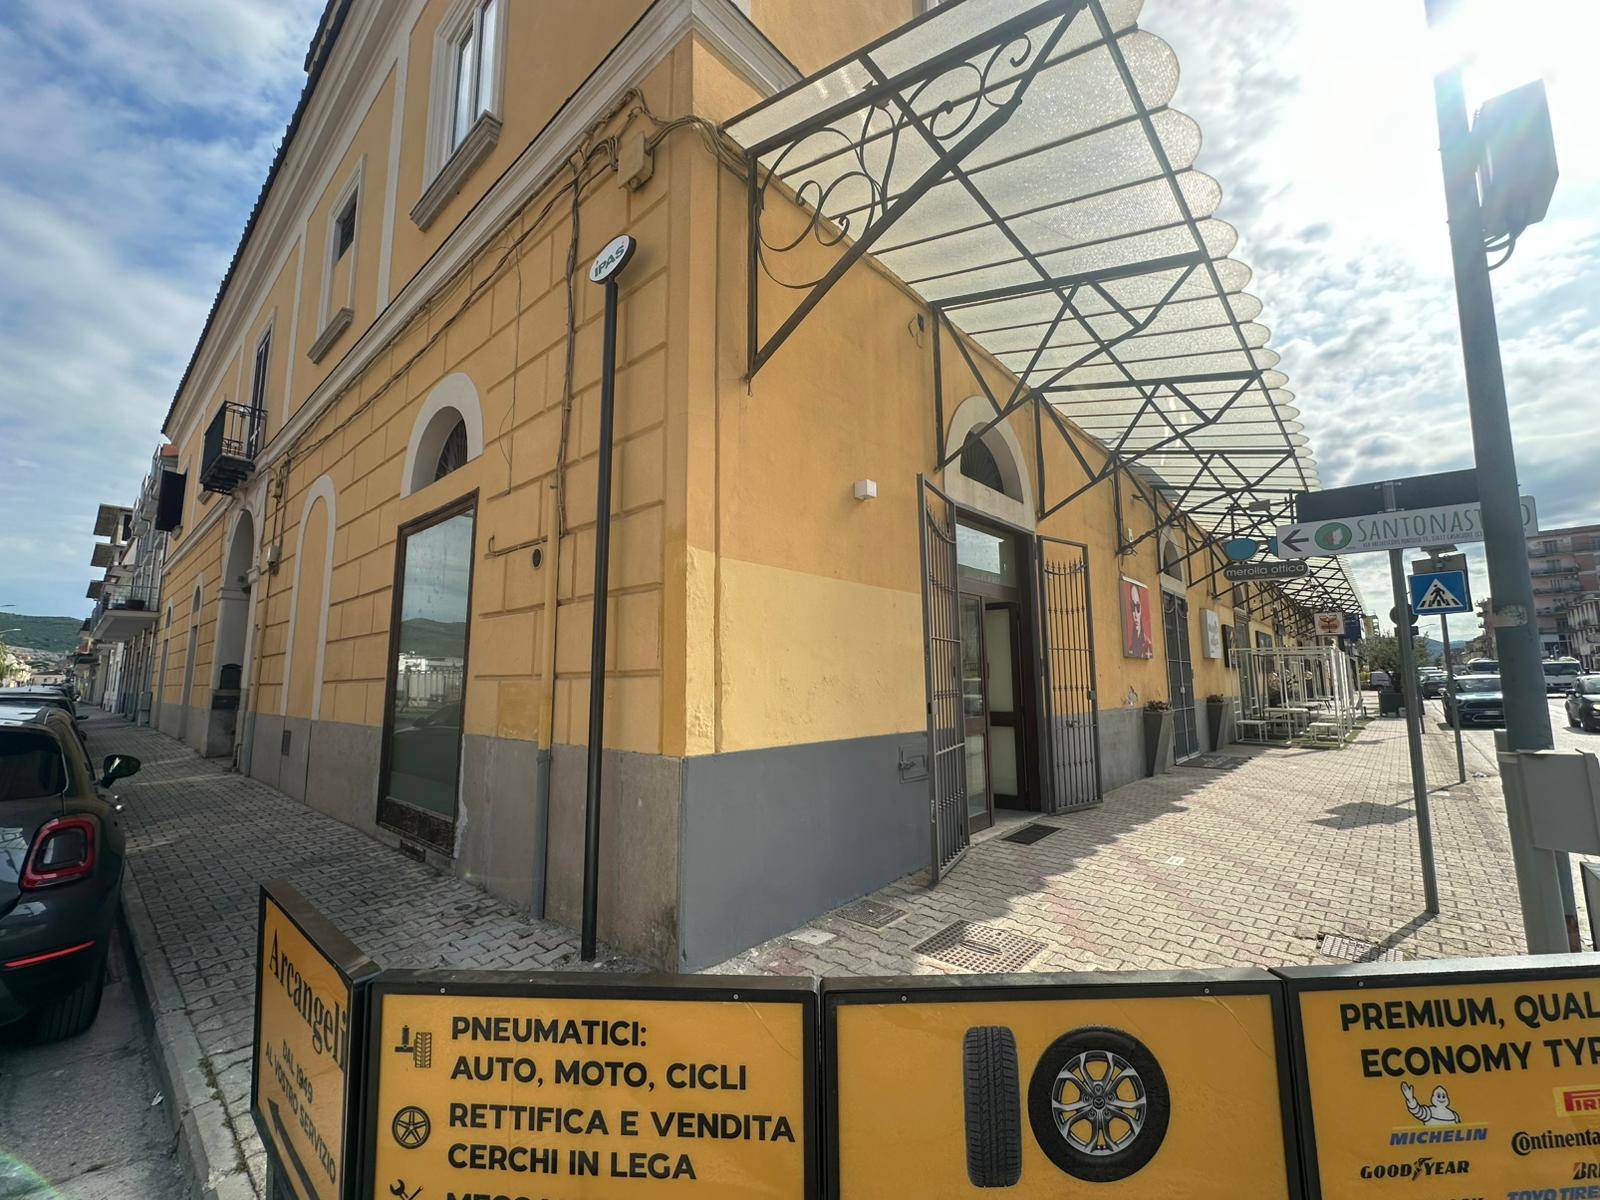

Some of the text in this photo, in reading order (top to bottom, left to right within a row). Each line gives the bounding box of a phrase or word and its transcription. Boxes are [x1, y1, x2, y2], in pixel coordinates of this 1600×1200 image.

[594, 244, 625, 278] IPAS
[1226, 566, 1268, 577] merolla
[1271, 563, 1305, 574] ottica
[269, 928, 348, 1071] Arcangeli
[1340, 997, 1505, 1031] PREMIUM,
[451, 1016, 647, 1047] PNEUMATICI:
[282, 1039, 313, 1104] DAL 1949
[450, 1055, 747, 1092] AUTO, MOTO, CICLI
[1360, 1041, 1532, 1078] ECONOMY
[265, 1041, 336, 1185] AL VOSTRO SERVIZIO
[449, 1102, 796, 1142] RETTIFICA E VENDITA
[1390, 1128, 1488, 1146] MICHELIN
[447, 1142, 697, 1180] CERCHI IN LEGA
